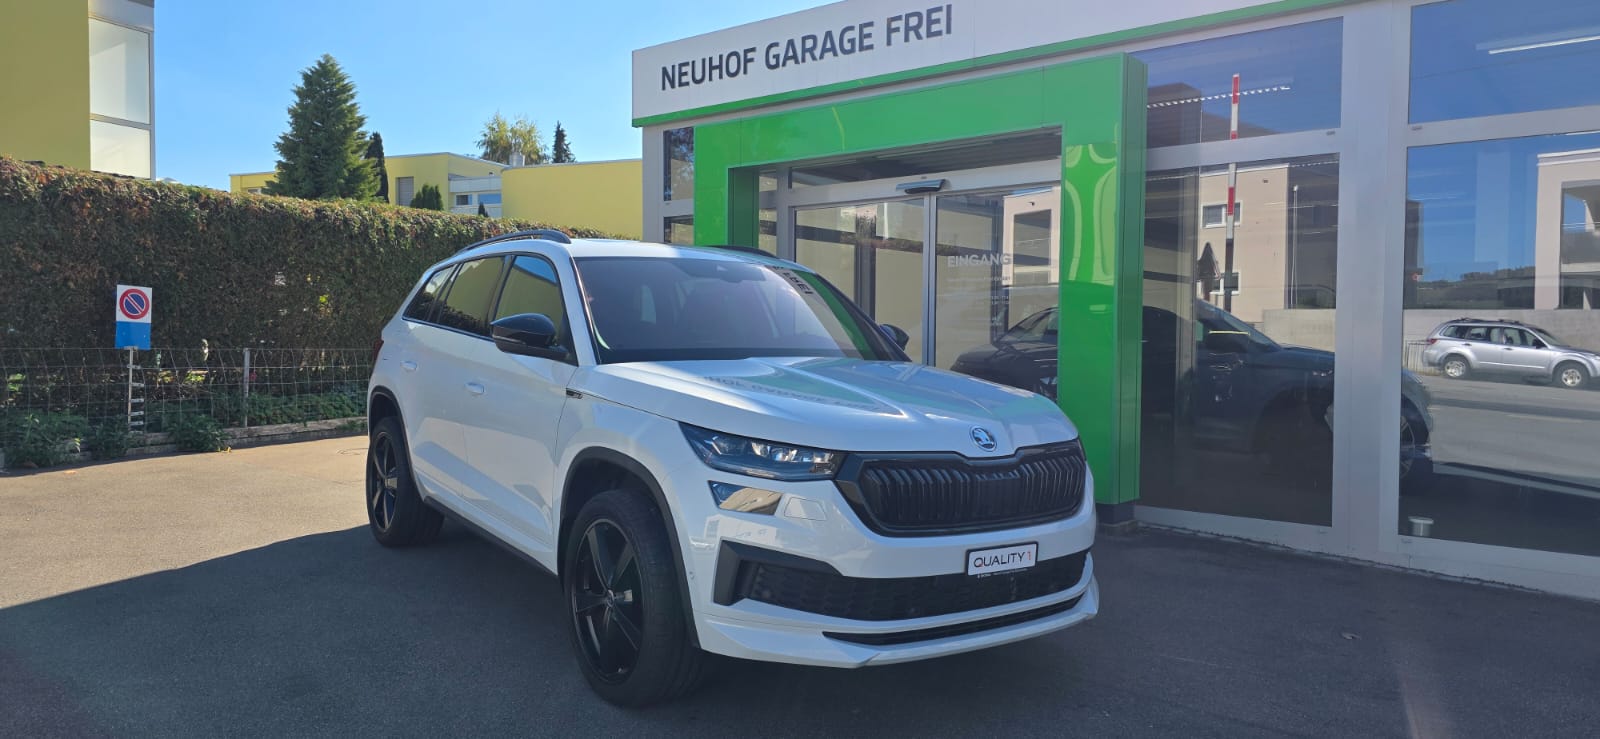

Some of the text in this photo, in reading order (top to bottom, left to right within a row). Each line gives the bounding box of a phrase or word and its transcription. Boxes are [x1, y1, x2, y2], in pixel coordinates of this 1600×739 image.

[661, 4, 952, 91] NEUHOF GARAGE FREI
[947, 253, 1013, 268] EINGANG
